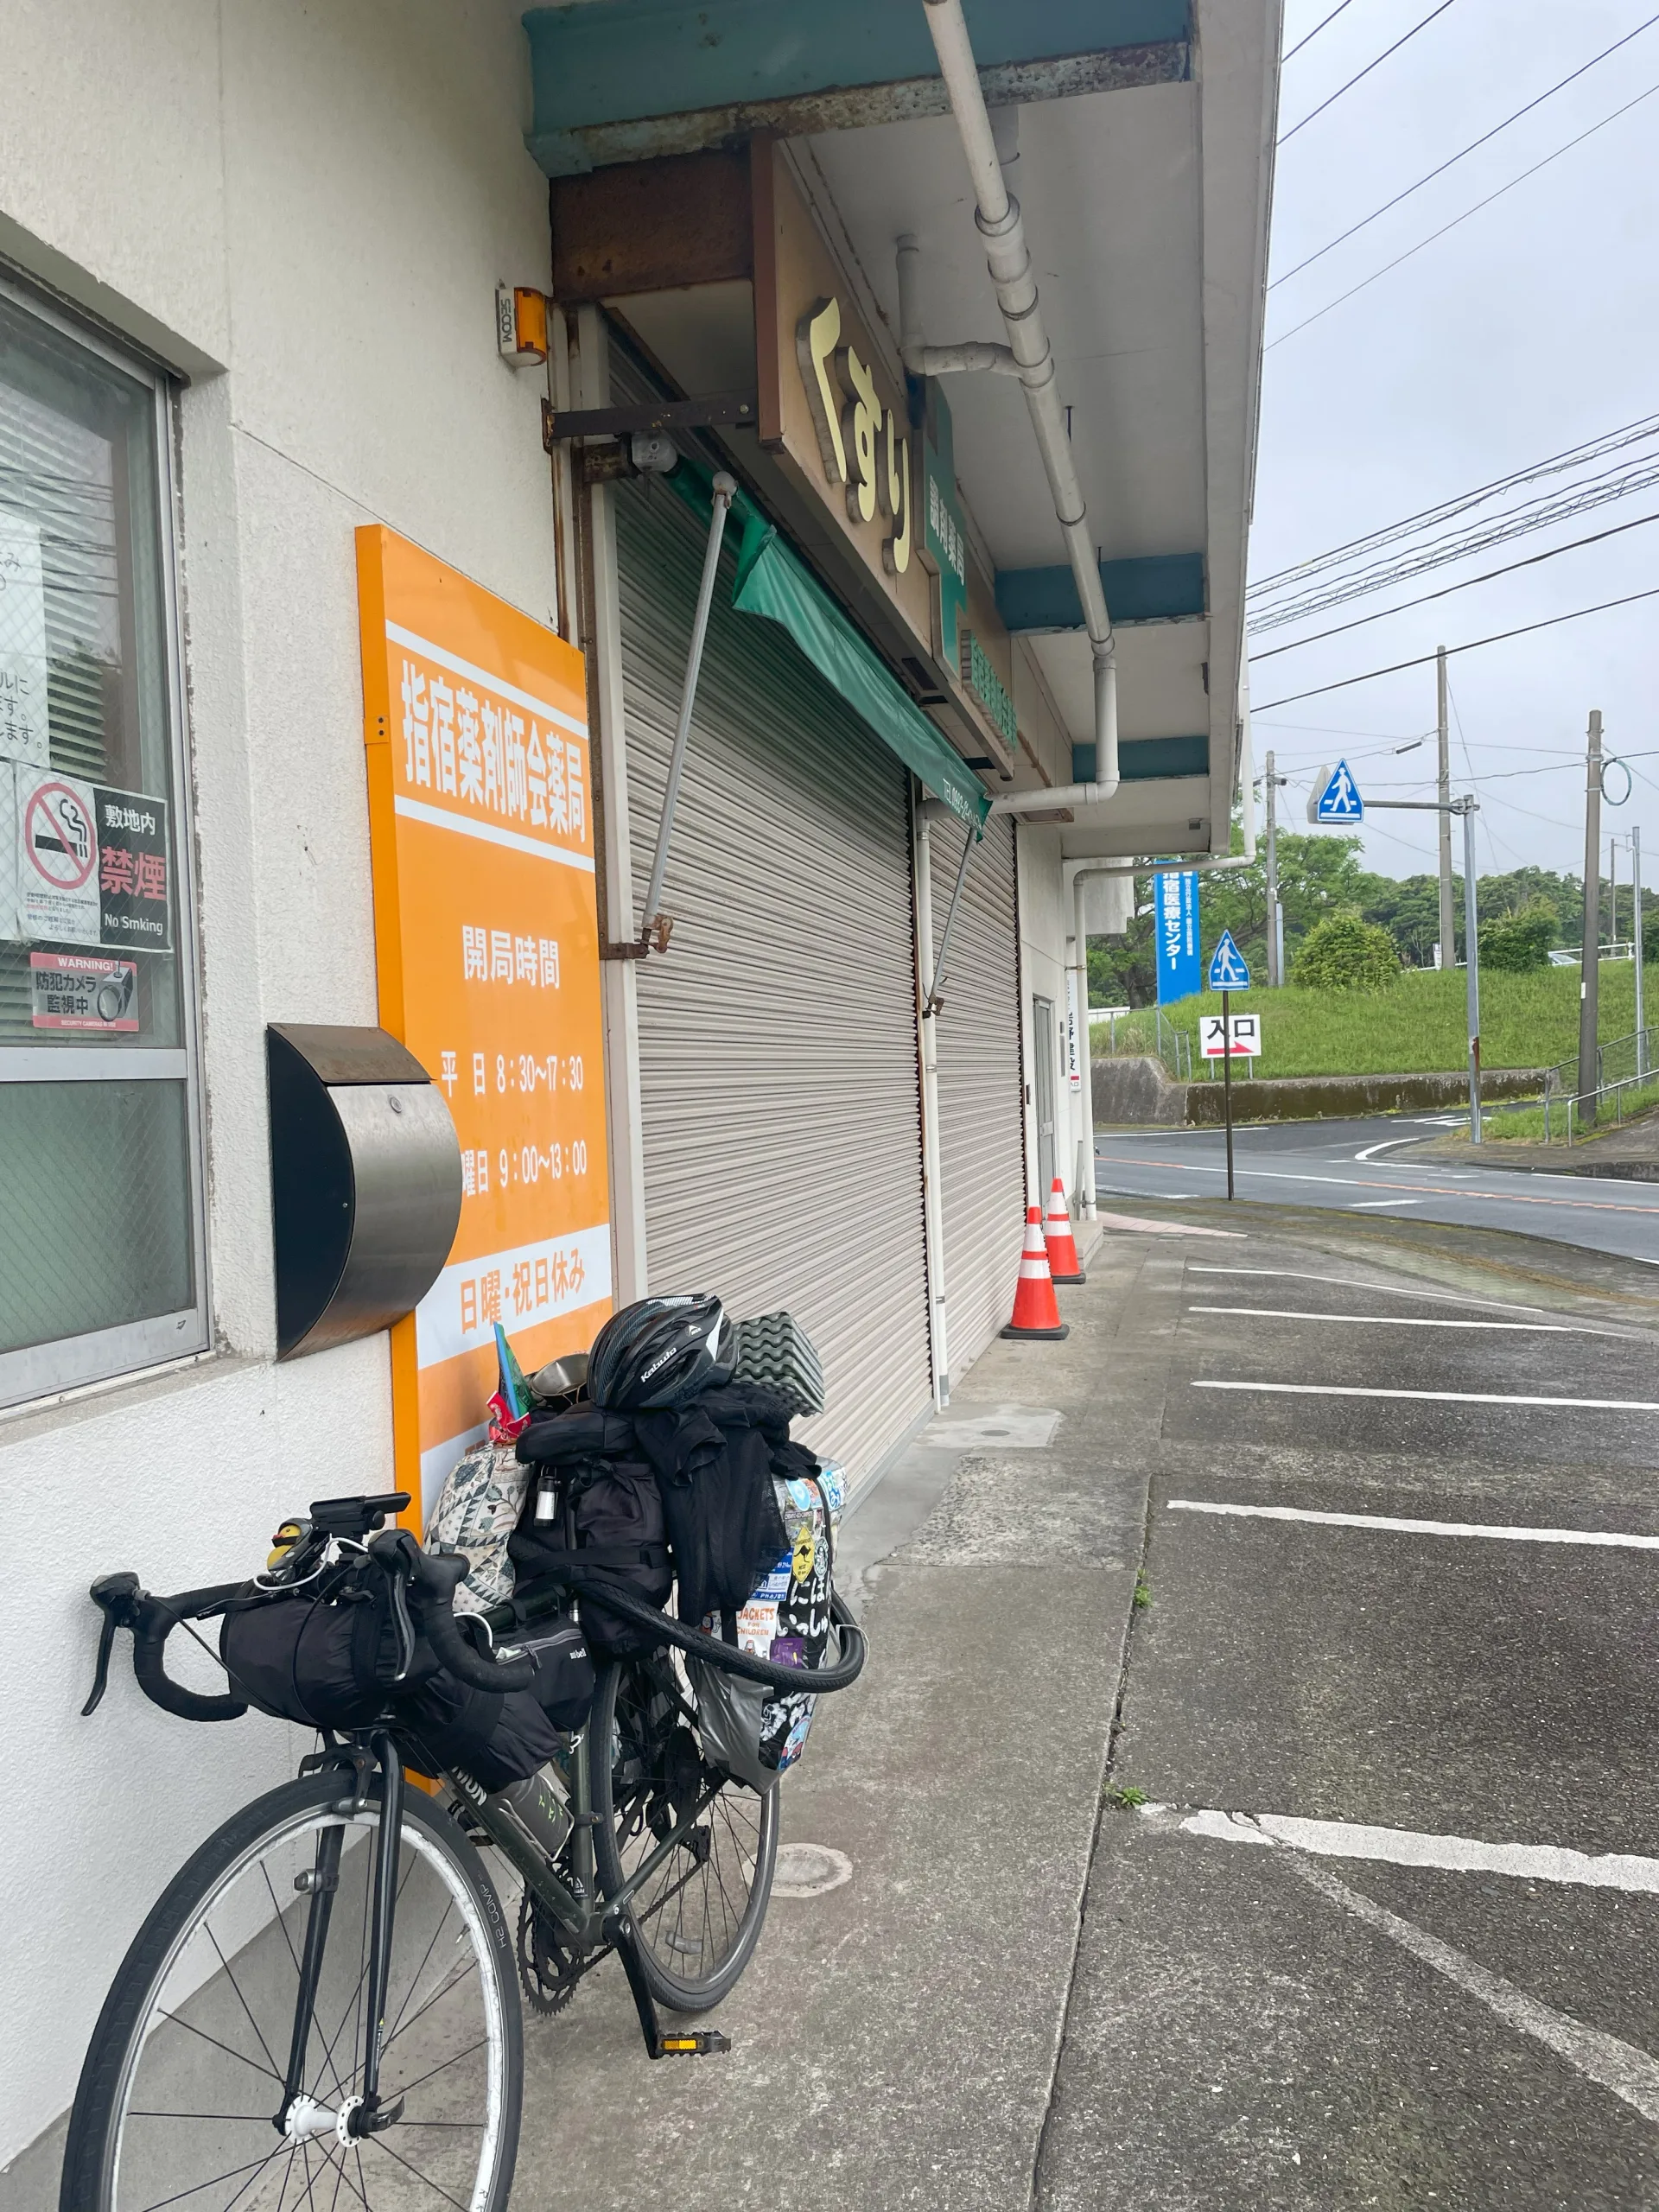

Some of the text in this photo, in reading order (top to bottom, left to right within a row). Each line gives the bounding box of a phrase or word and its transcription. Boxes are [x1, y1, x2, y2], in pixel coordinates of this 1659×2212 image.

[500, 298, 513, 343] SECOM
[809, 296, 911, 575] くすり
[401, 659, 586, 843] 指宿薬剤師会薬局
[105, 804, 156, 836] 敷地内
[100, 846, 167, 900] 禁煙
[105, 912, 119, 928] No
[57, 957, 113, 971] WARNING!
[462, 925, 561, 989] 開局時間
[35, 970, 97, 993] 防犯カメラ
[47, 994, 88, 1015] 監視中
[1206, 1019, 1255, 1039] 入口
[640, 1347, 677, 1383] Kabuto
[737, 1607, 775, 1621] JACKETS
[480, 1883, 500, 1924] COMP
